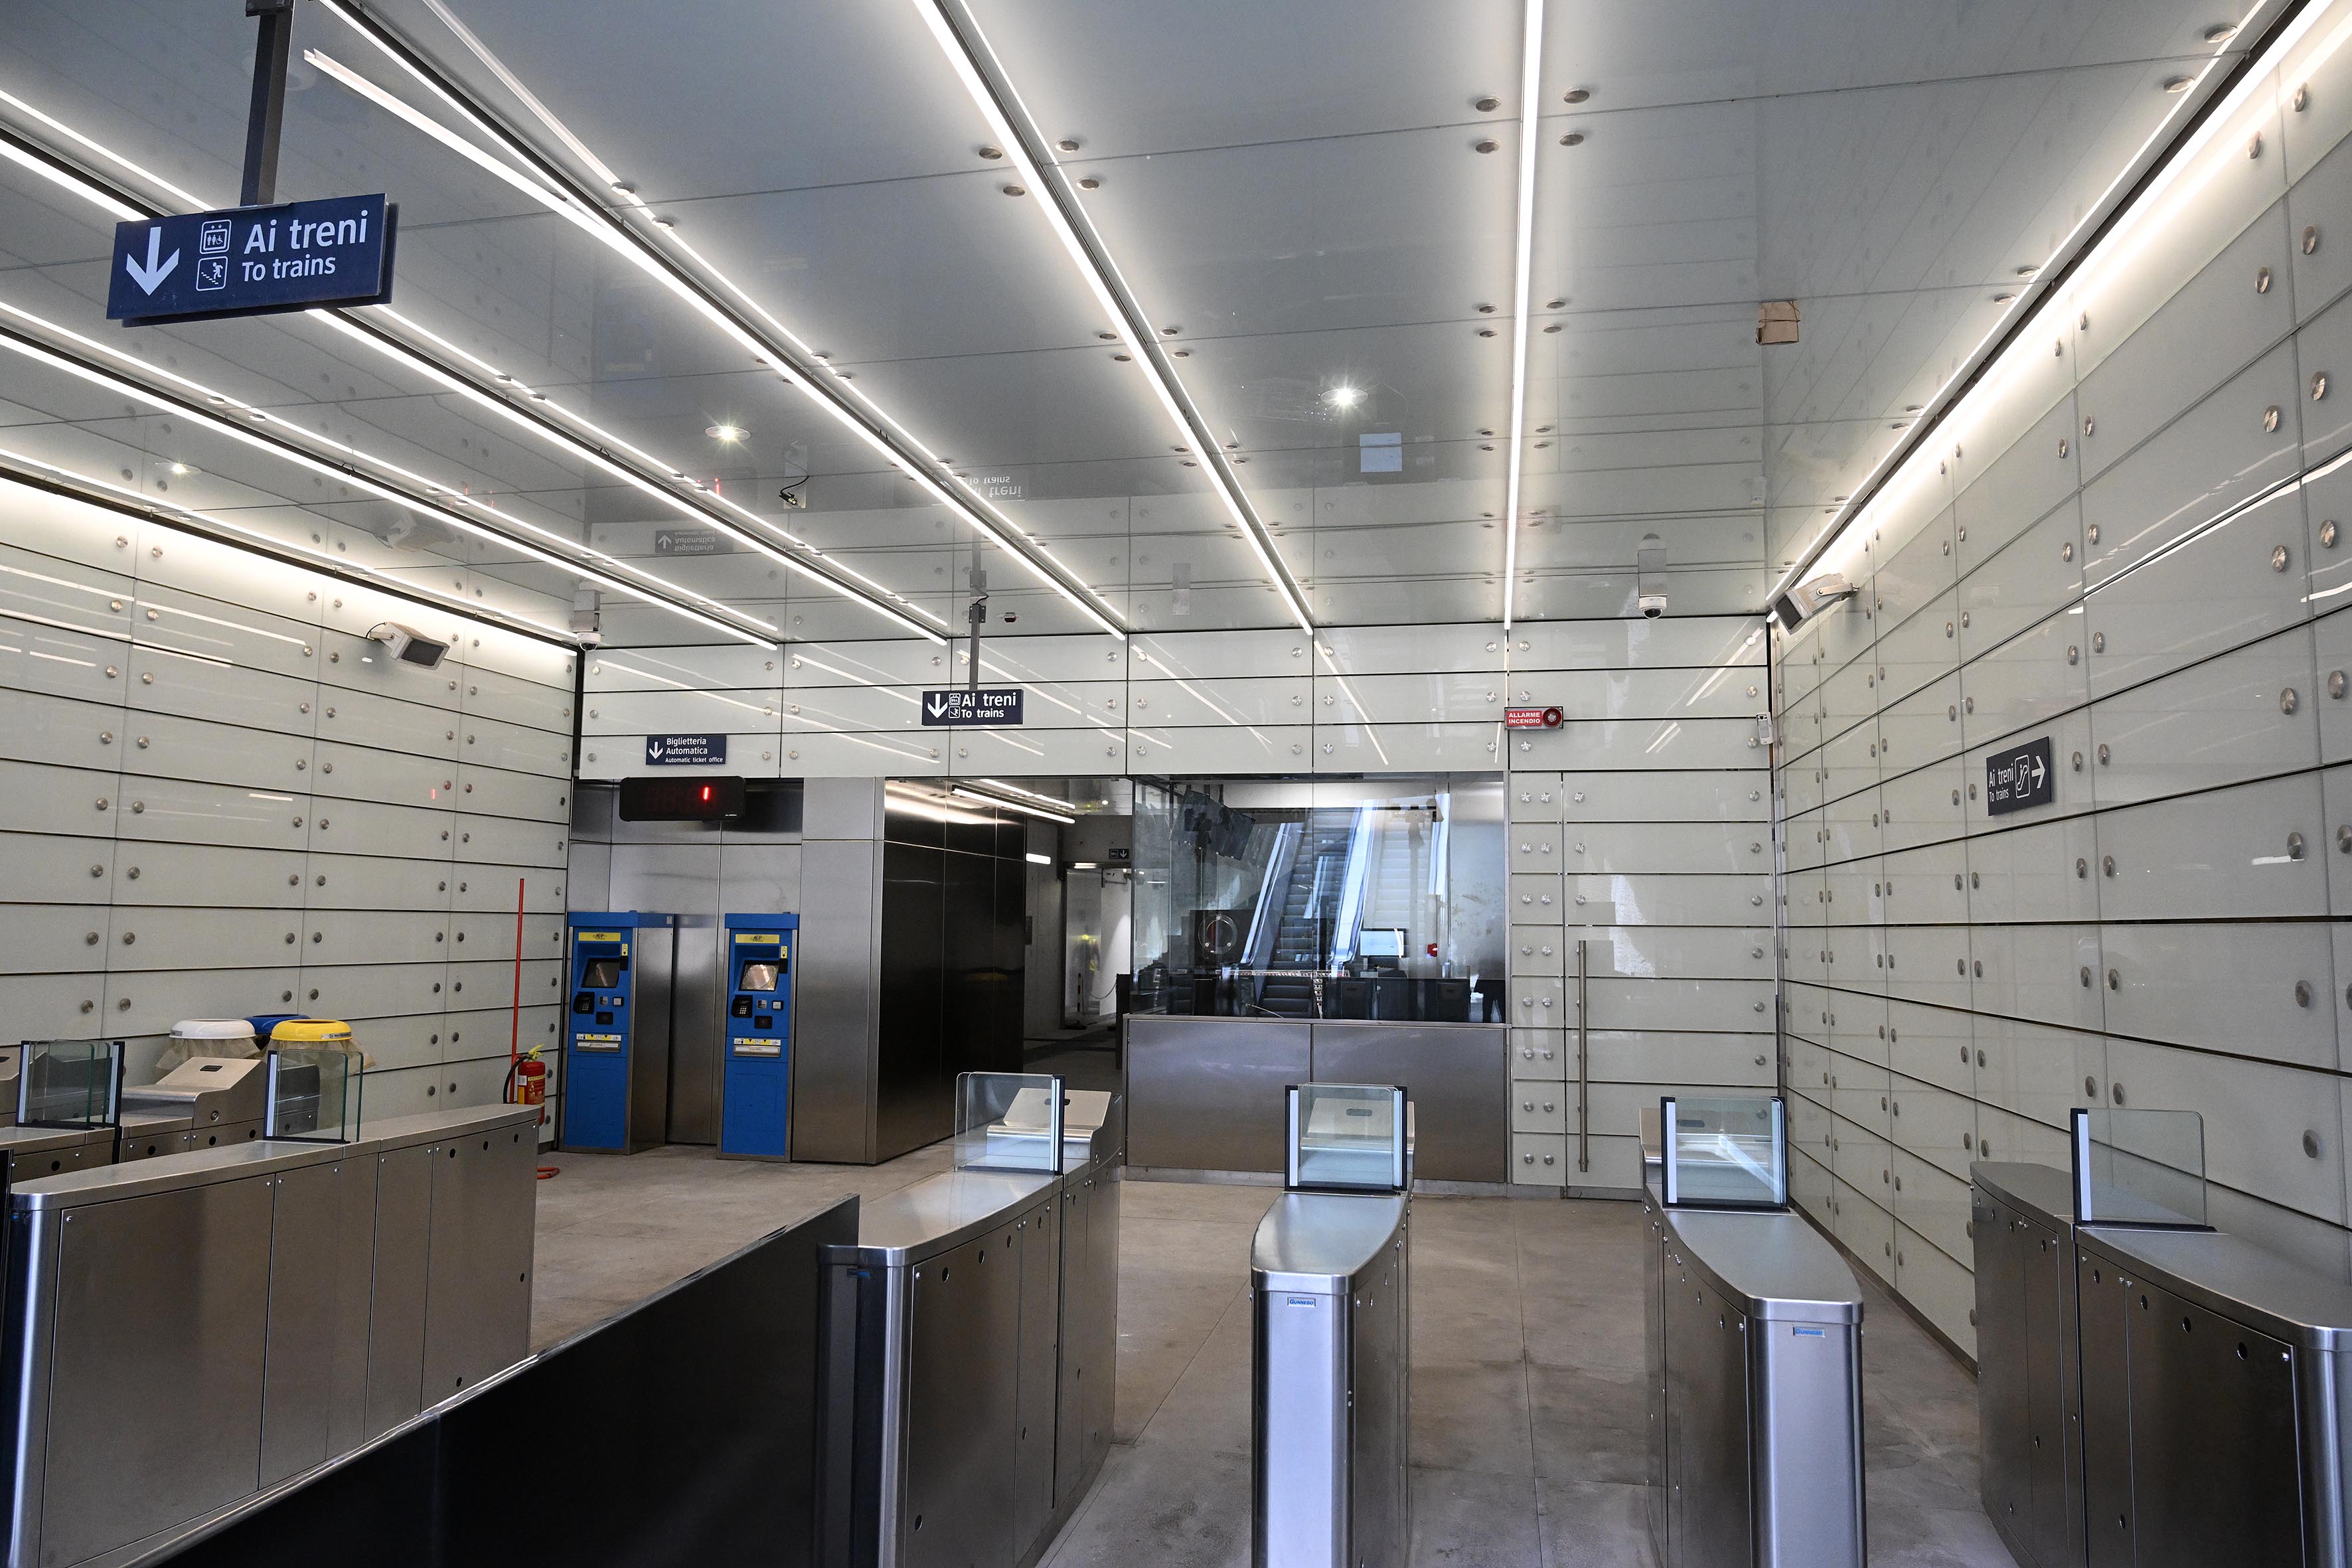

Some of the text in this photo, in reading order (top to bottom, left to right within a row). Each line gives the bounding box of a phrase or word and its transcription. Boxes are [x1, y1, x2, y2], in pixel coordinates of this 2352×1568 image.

[244, 210, 368, 254] Ai treni
[242, 254, 336, 281] To trains
[962, 692, 1017, 707] Ai treni
[961, 708, 1004, 718] To trains
[666, 737, 706, 747] Biglietteria
[1989, 763, 2014, 788] Ai treni
[1989, 787, 2009, 803] To trains
